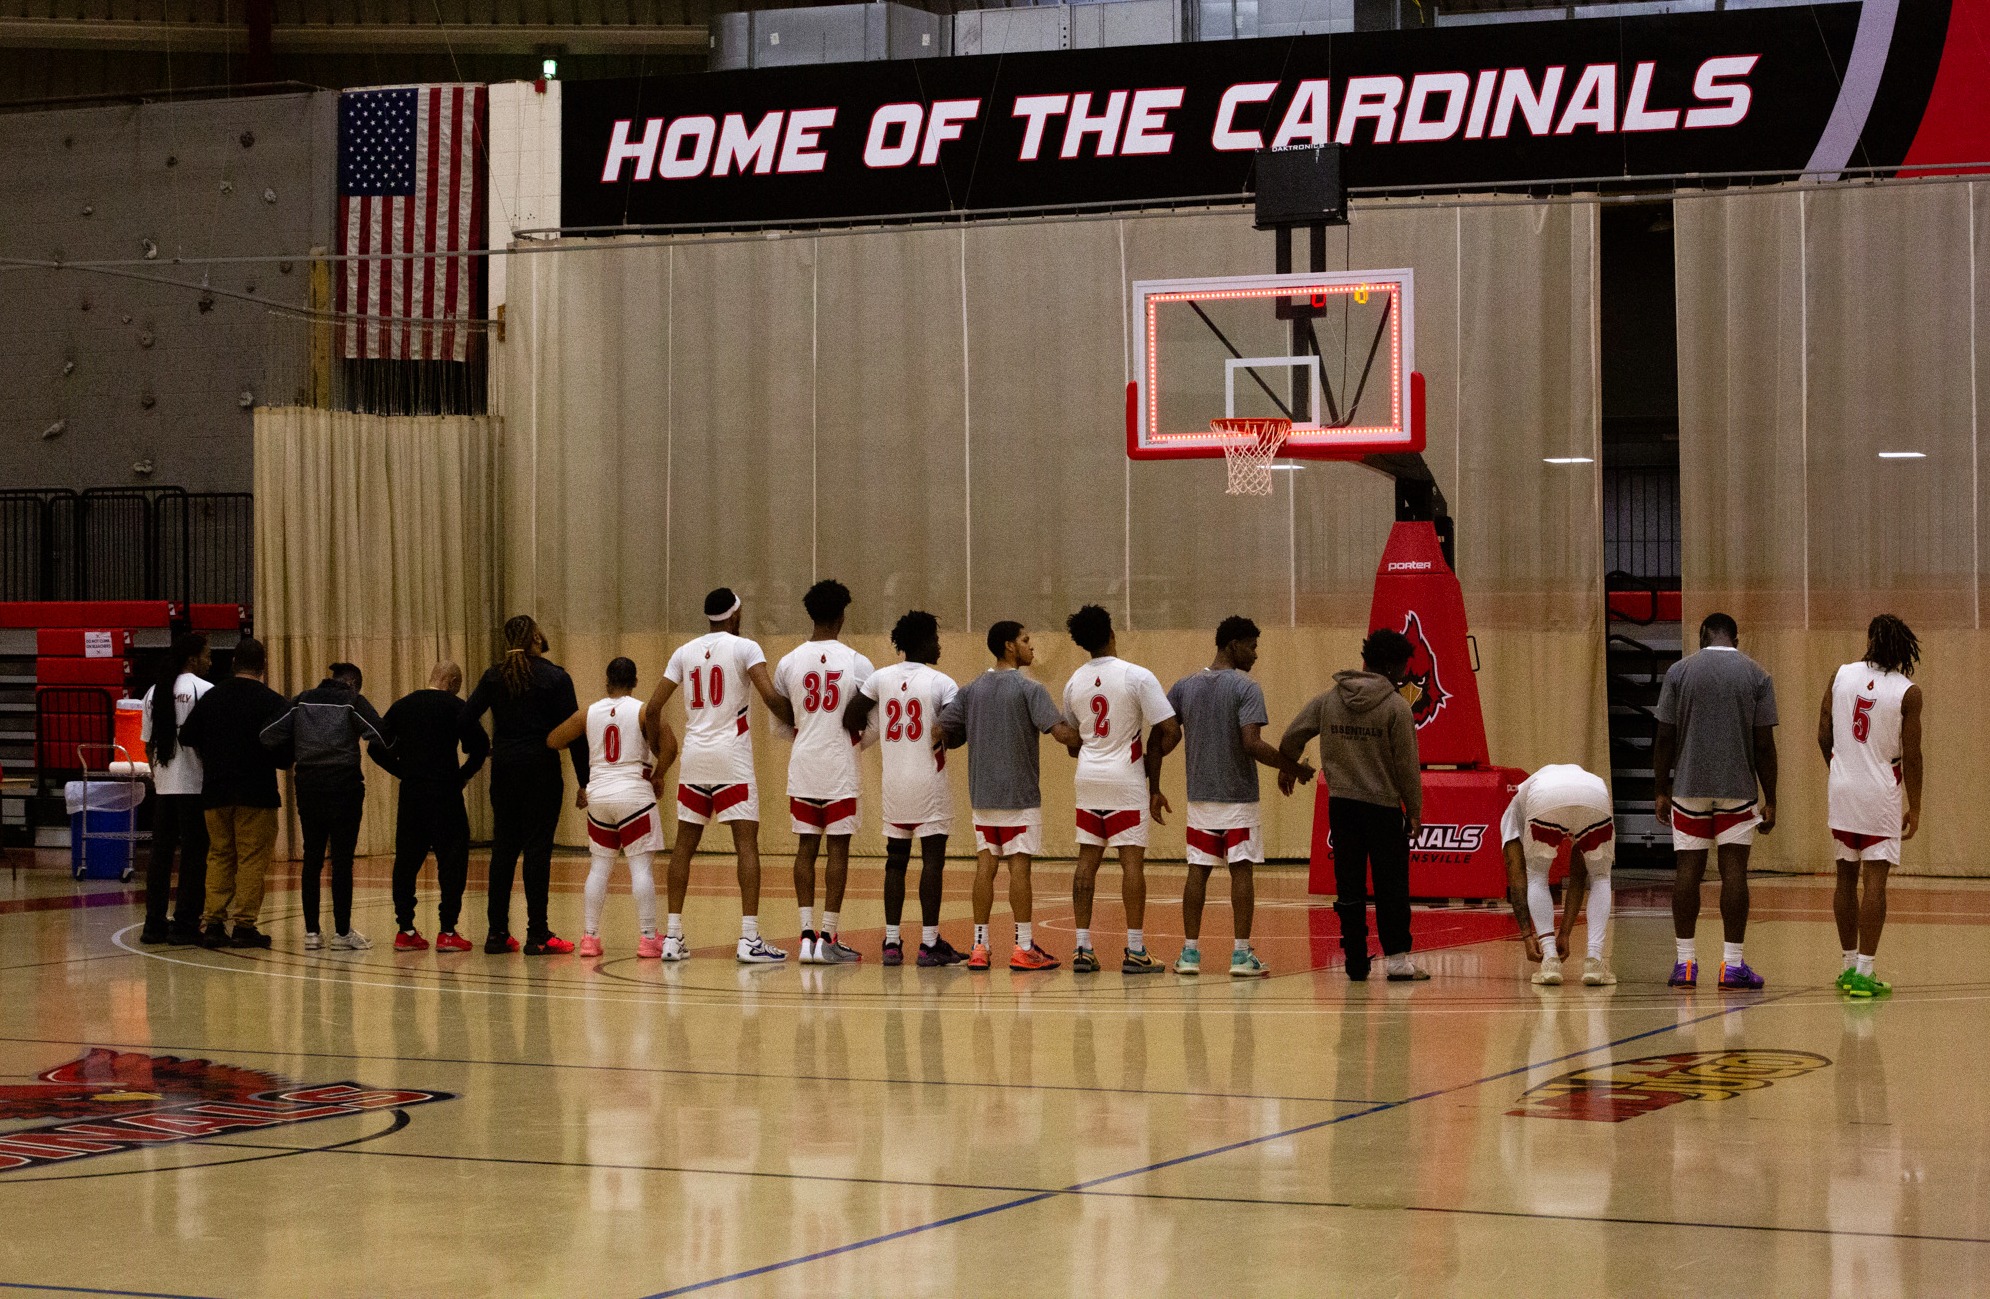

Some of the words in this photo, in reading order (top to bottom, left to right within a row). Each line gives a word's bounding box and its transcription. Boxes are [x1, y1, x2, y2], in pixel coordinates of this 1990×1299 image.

[601, 106, 838, 183] HOME
[863, 97, 982, 169] OF
[1012, 86, 1186, 162] THE
[1211, 53, 1763, 151] CARDINALS
[1271, 144, 1325, 153] DAKTRONICS
[689, 665, 725, 710] 10
[803, 670, 843, 713] 35
[885, 698, 923, 742] 23
[1090, 694, 1110, 738] 2
[1852, 694, 1877, 744] 5
[603, 724, 621, 764] 0
[1411, 853, 1472, 864] NSVILLE
